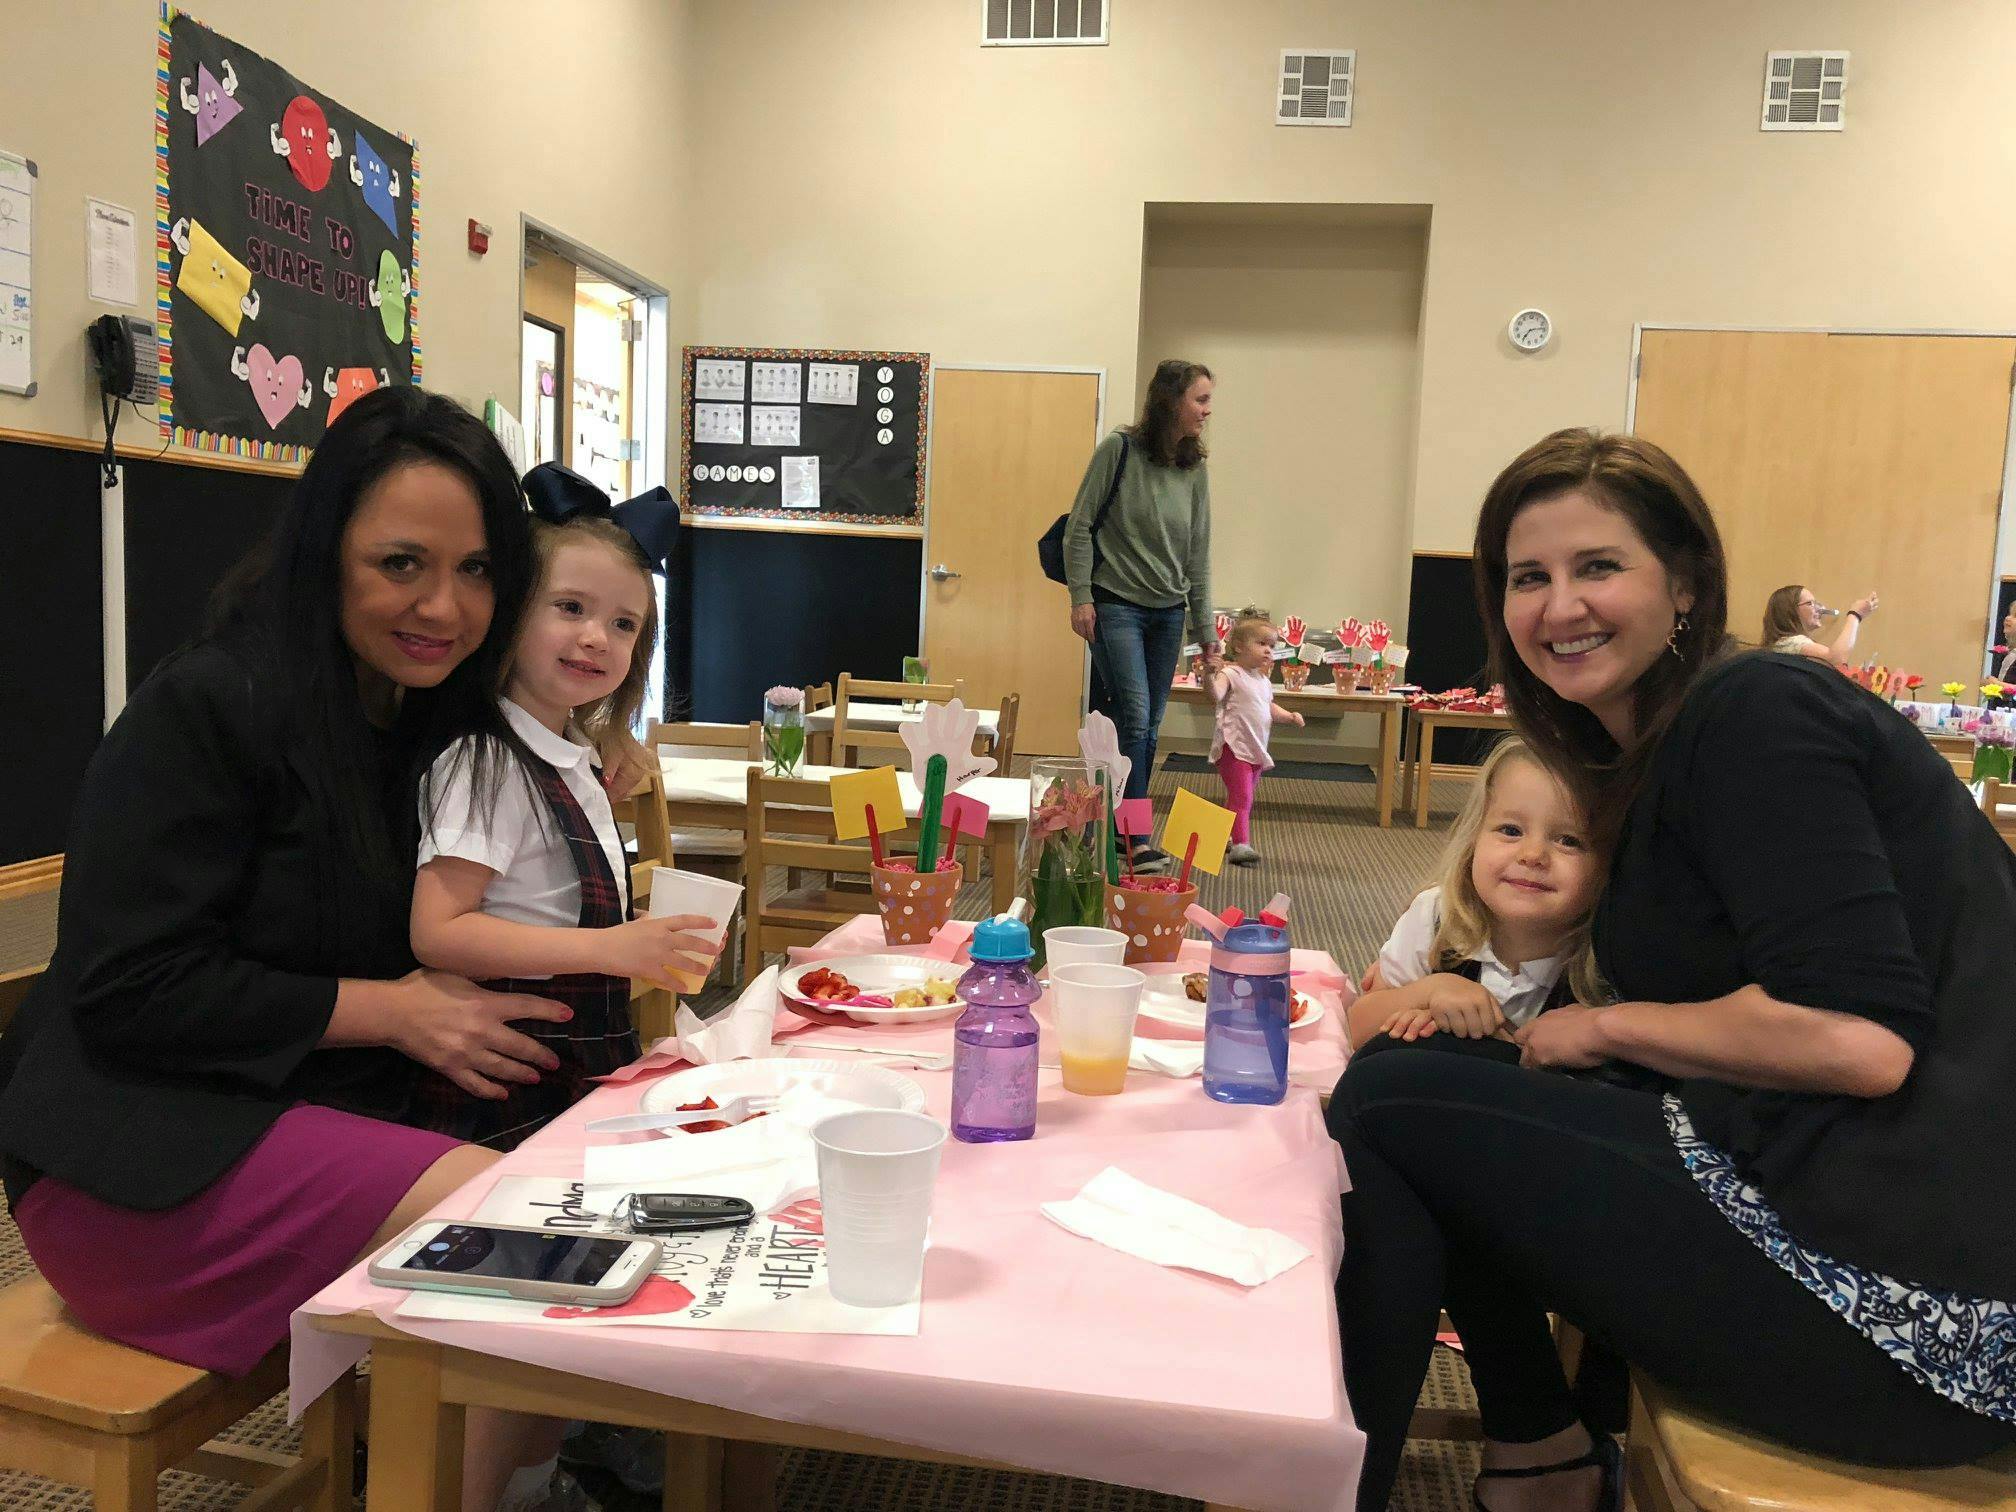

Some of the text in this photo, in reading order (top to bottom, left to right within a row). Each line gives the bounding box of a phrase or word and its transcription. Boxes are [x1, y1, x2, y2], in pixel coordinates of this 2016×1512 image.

[325, 216, 355, 260] TO
[246, 236, 367, 310] SHAPE UP!
[695, 465, 773, 480] GAMES
[720, 1244, 741, 1264] never
[744, 1244, 763, 1258] and
[758, 1225, 825, 1290] HEART
[705, 1266, 735, 1288] that's
[696, 1290, 727, 1308] love
